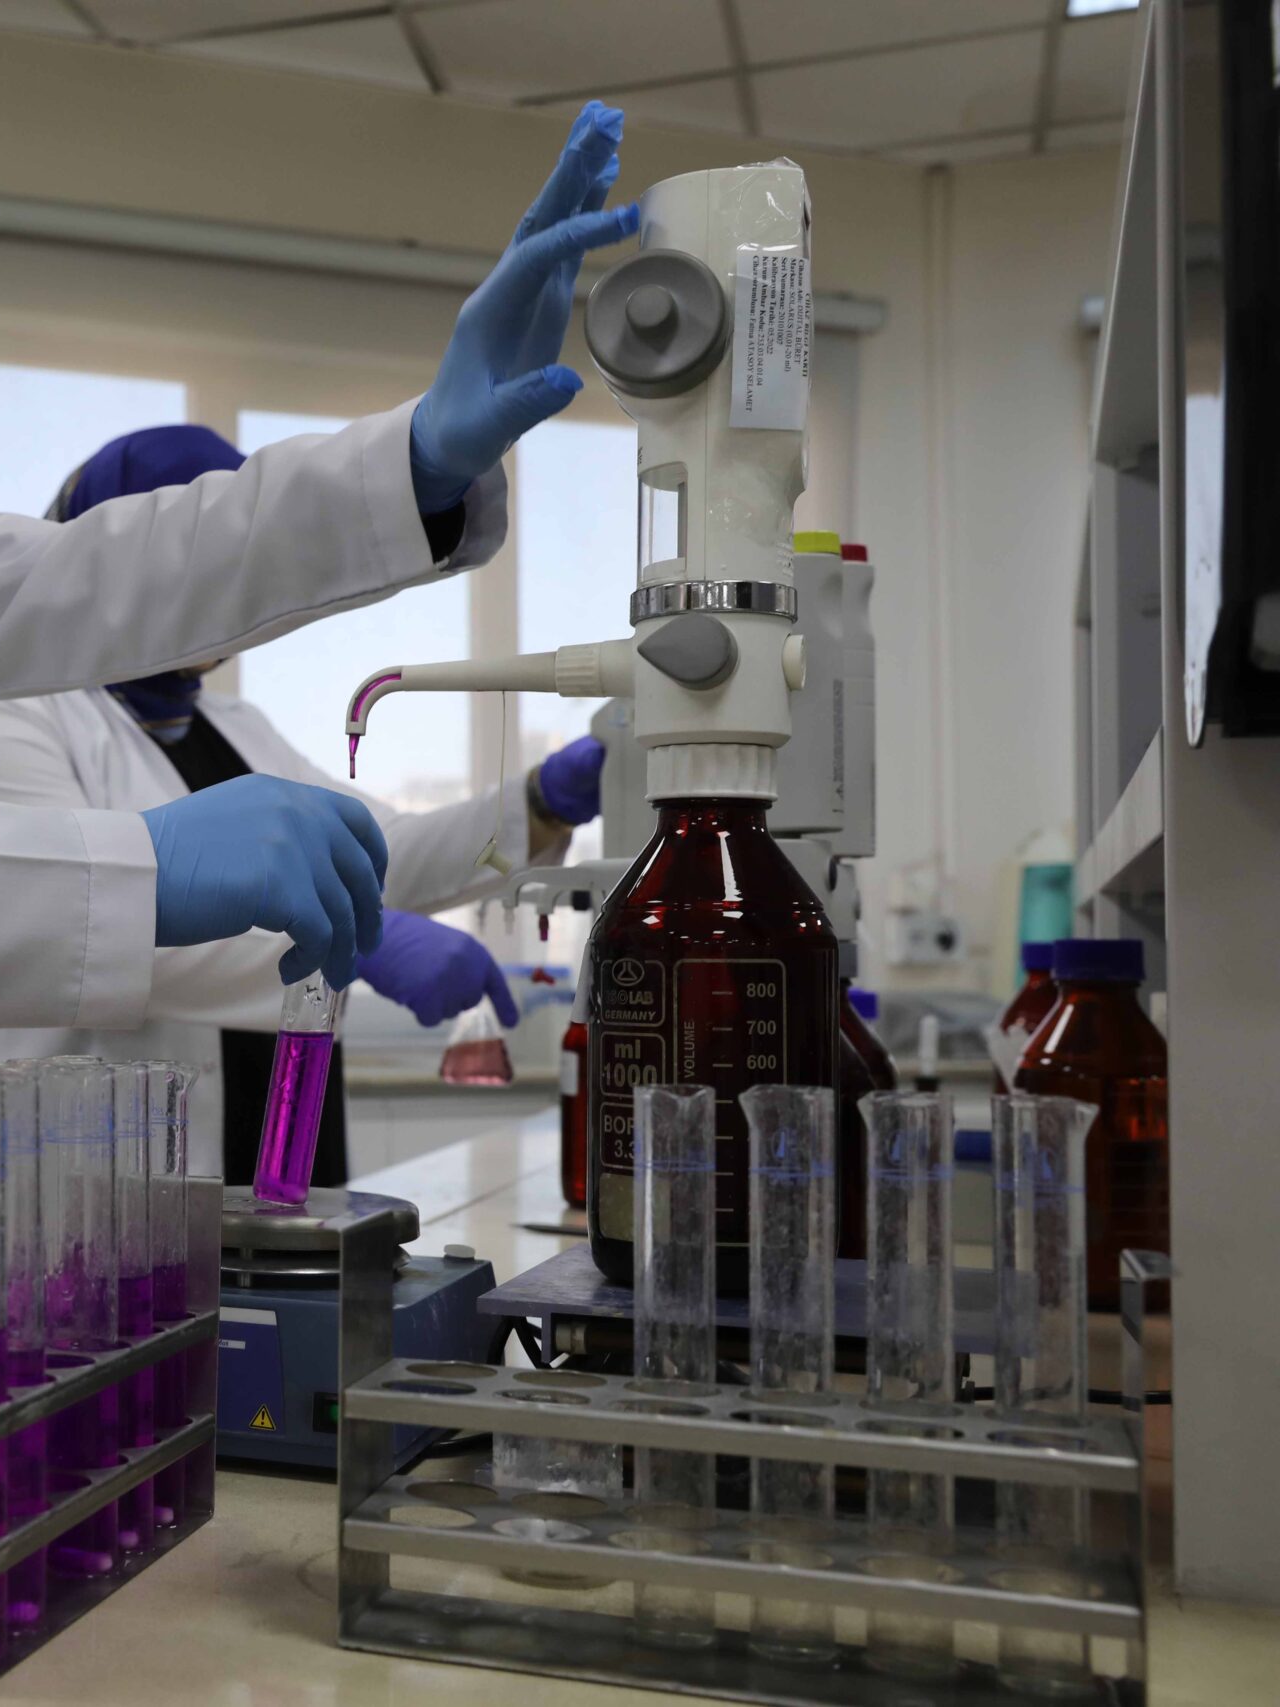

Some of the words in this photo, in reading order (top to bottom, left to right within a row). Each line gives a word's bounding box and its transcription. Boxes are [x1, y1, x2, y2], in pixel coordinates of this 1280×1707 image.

[746, 983, 776, 998] 800
[605, 1010, 657, 1021] GERMANY
[746, 1020, 777, 1035] 700
[615, 1039, 641, 1059] ml
[684, 1019, 695, 1078] VOLUME
[746, 1055, 777, 1070] 600
[603, 1062, 658, 1087] 1000
